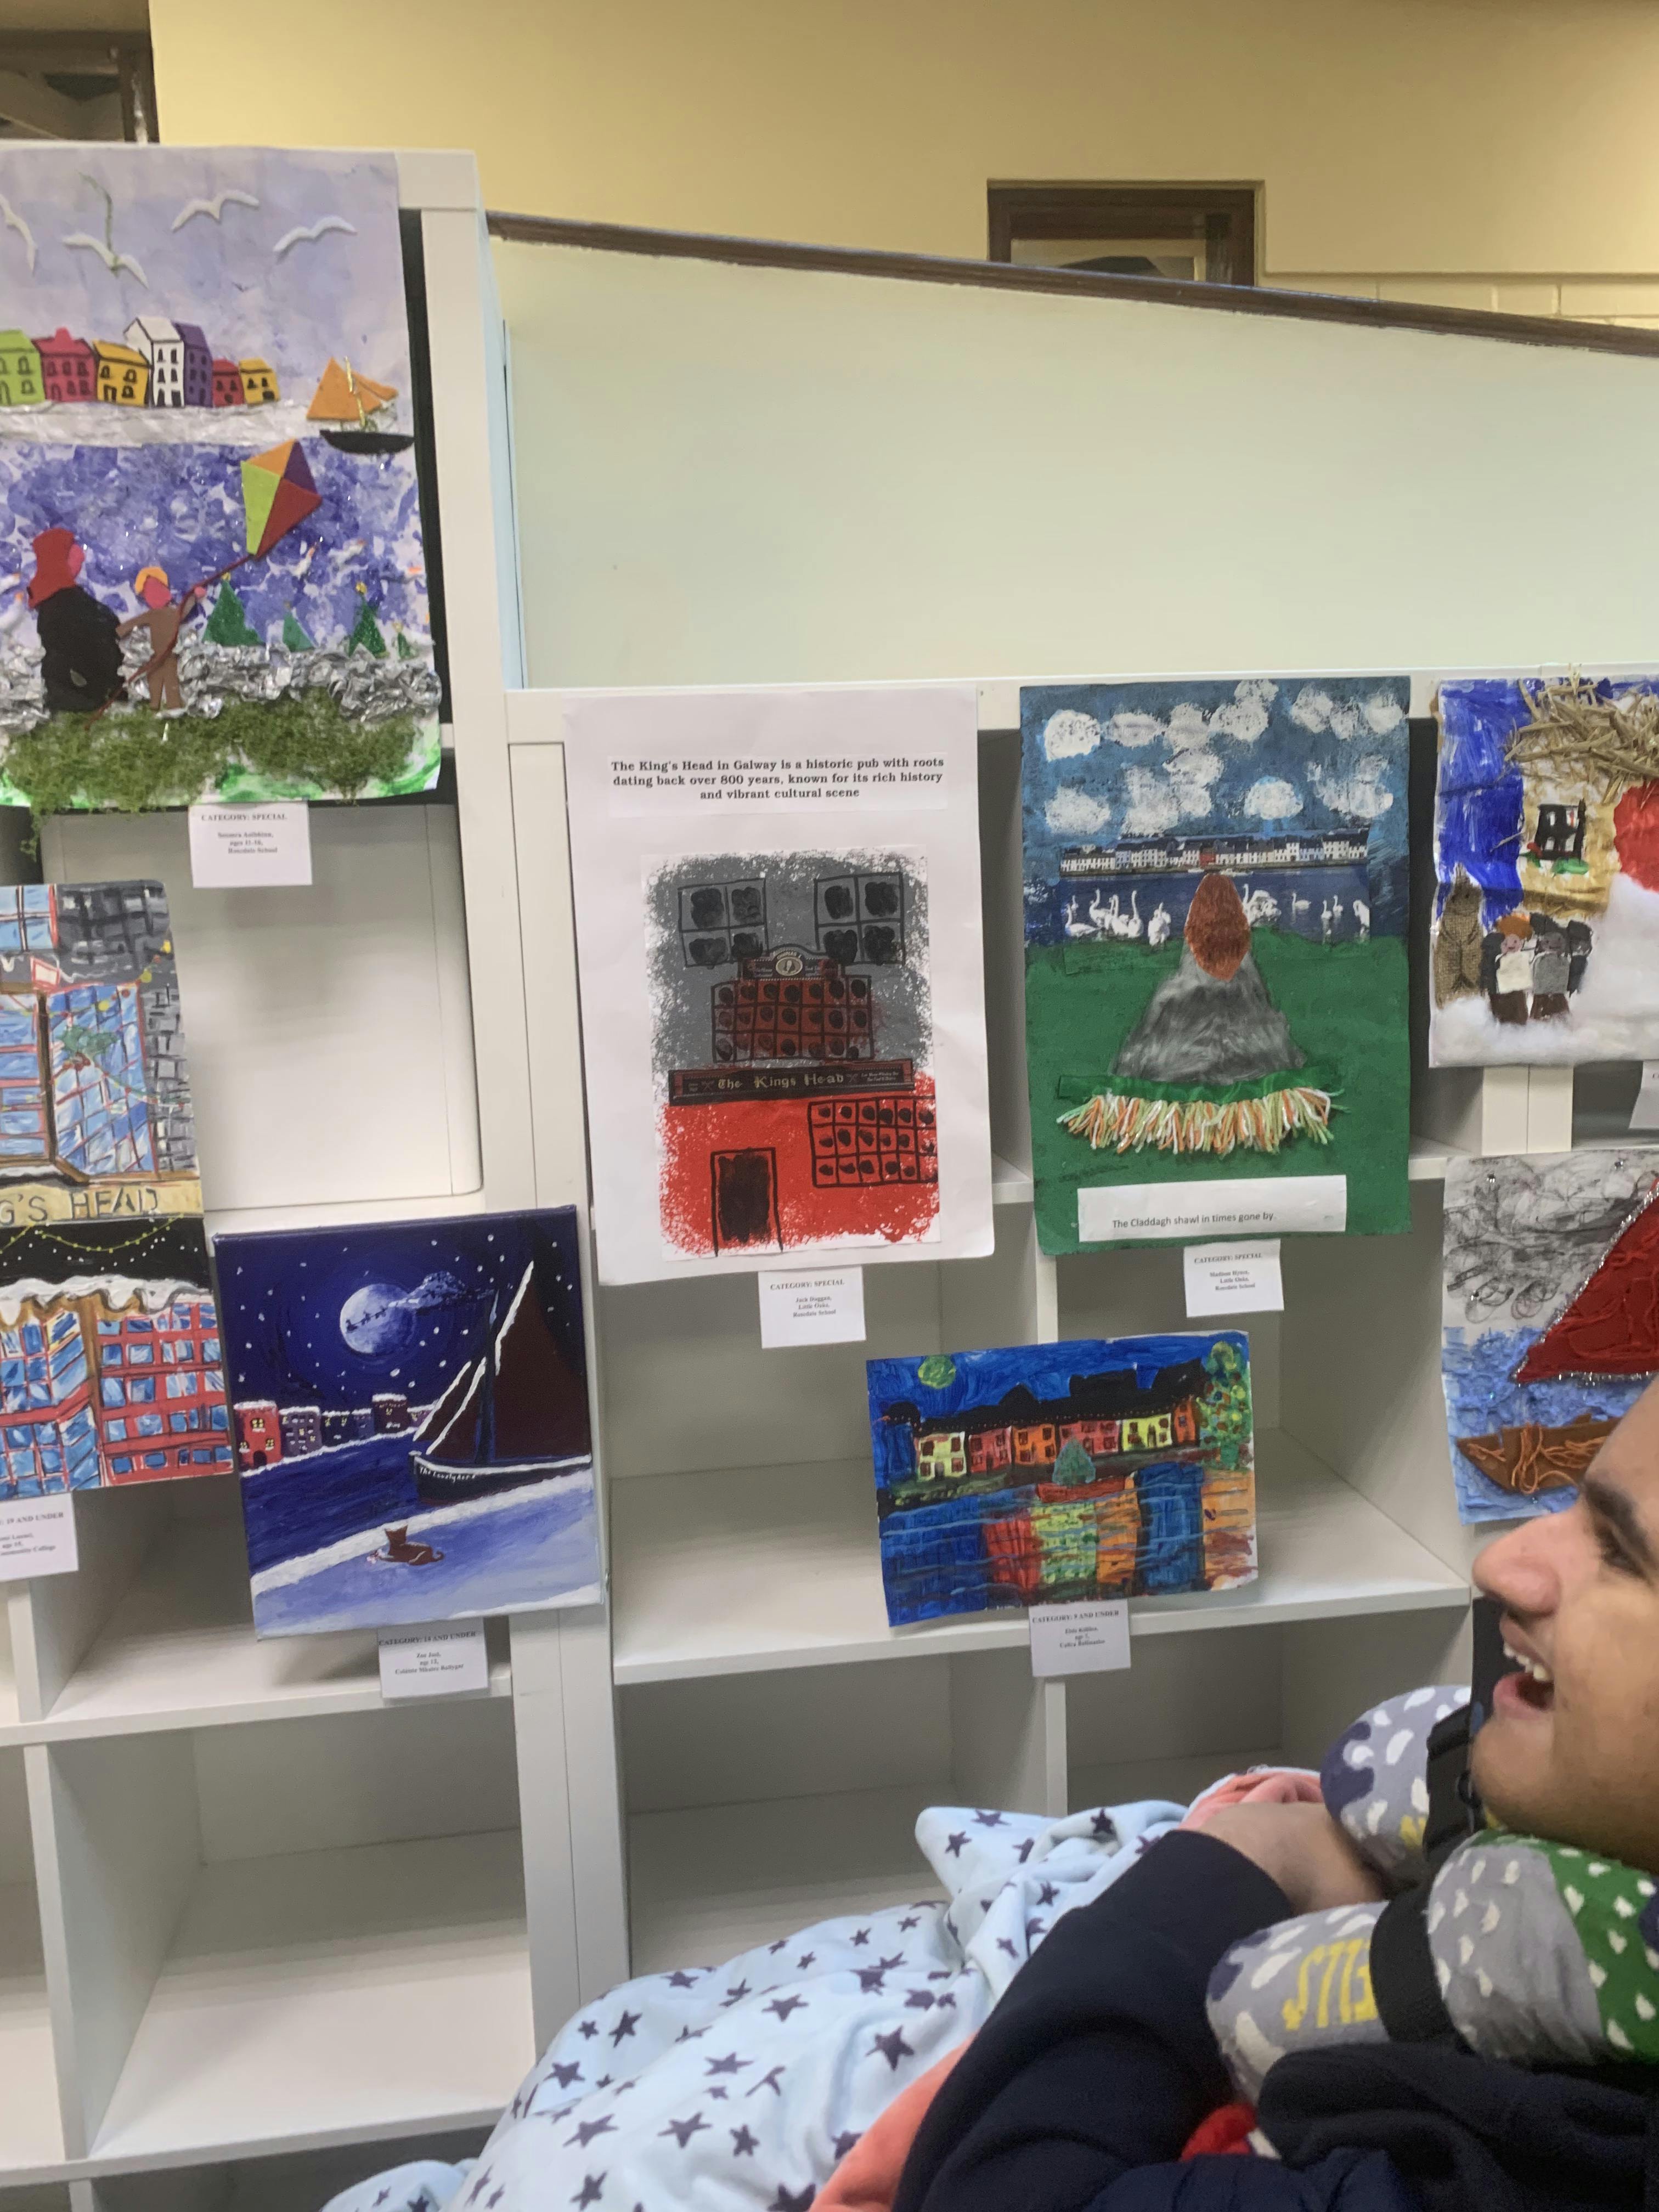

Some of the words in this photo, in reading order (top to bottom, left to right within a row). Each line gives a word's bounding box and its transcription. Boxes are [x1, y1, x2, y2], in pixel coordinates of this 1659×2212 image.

[611, 761, 635, 771] The
[639, 760, 678, 774] King's
[682, 760, 713, 770] Head
[718, 760, 729, 770] in
[733, 759, 777, 772] Galway
[781, 759, 792, 769] is
[806, 759, 853, 769] historic
[857, 758, 879, 770] pub
[883, 758, 909, 768] with
[913, 758, 944, 767] roots
[613, 776, 653, 788] dating
[657, 775, 686, 785] back
[690, 777, 716, 785] over
[720, 775, 744, 785] 800
[748, 776, 783, 786] years,
[788, 774, 828, 783] known
[832, 773, 849, 783] for
[853, 773, 868, 782] its
[872, 772, 896, 782] rich
[900, 772, 943, 783] history
[700, 789, 723, 799] and
[727, 789, 771, 799] vibrant
[775, 788, 822, 798] cultural
[826, 789, 860, 798] scene
[718, 1079, 743, 1090] The
[754, 1075, 796, 1088] Kings
[70, 1187, 159, 1220] HEAD
[1112, 1220, 1128, 1228] The
[1130, 1216, 1171, 1228] Claddagh
[1173, 1215, 1199, 1224] shawl
[1212, 1214, 1236, 1222] times
[1238, 1214, 1260, 1223] gone
[1194, 1256, 1233, 1265] CATEGORY:
[770, 1282, 812, 1290] CATEGORY:
[16, 1515, 34, 1523] AND
[35, 1511, 64, 1521] UNDER
[1032, 1615, 1073, 1624] CATEGORY:
[1095, 1610, 1120, 1618] UNDER
[379, 1637, 422, 1646] CATEGORY:
[433, 1633, 449, 1641] AND
[450, 1630, 476, 1639] UNDER
